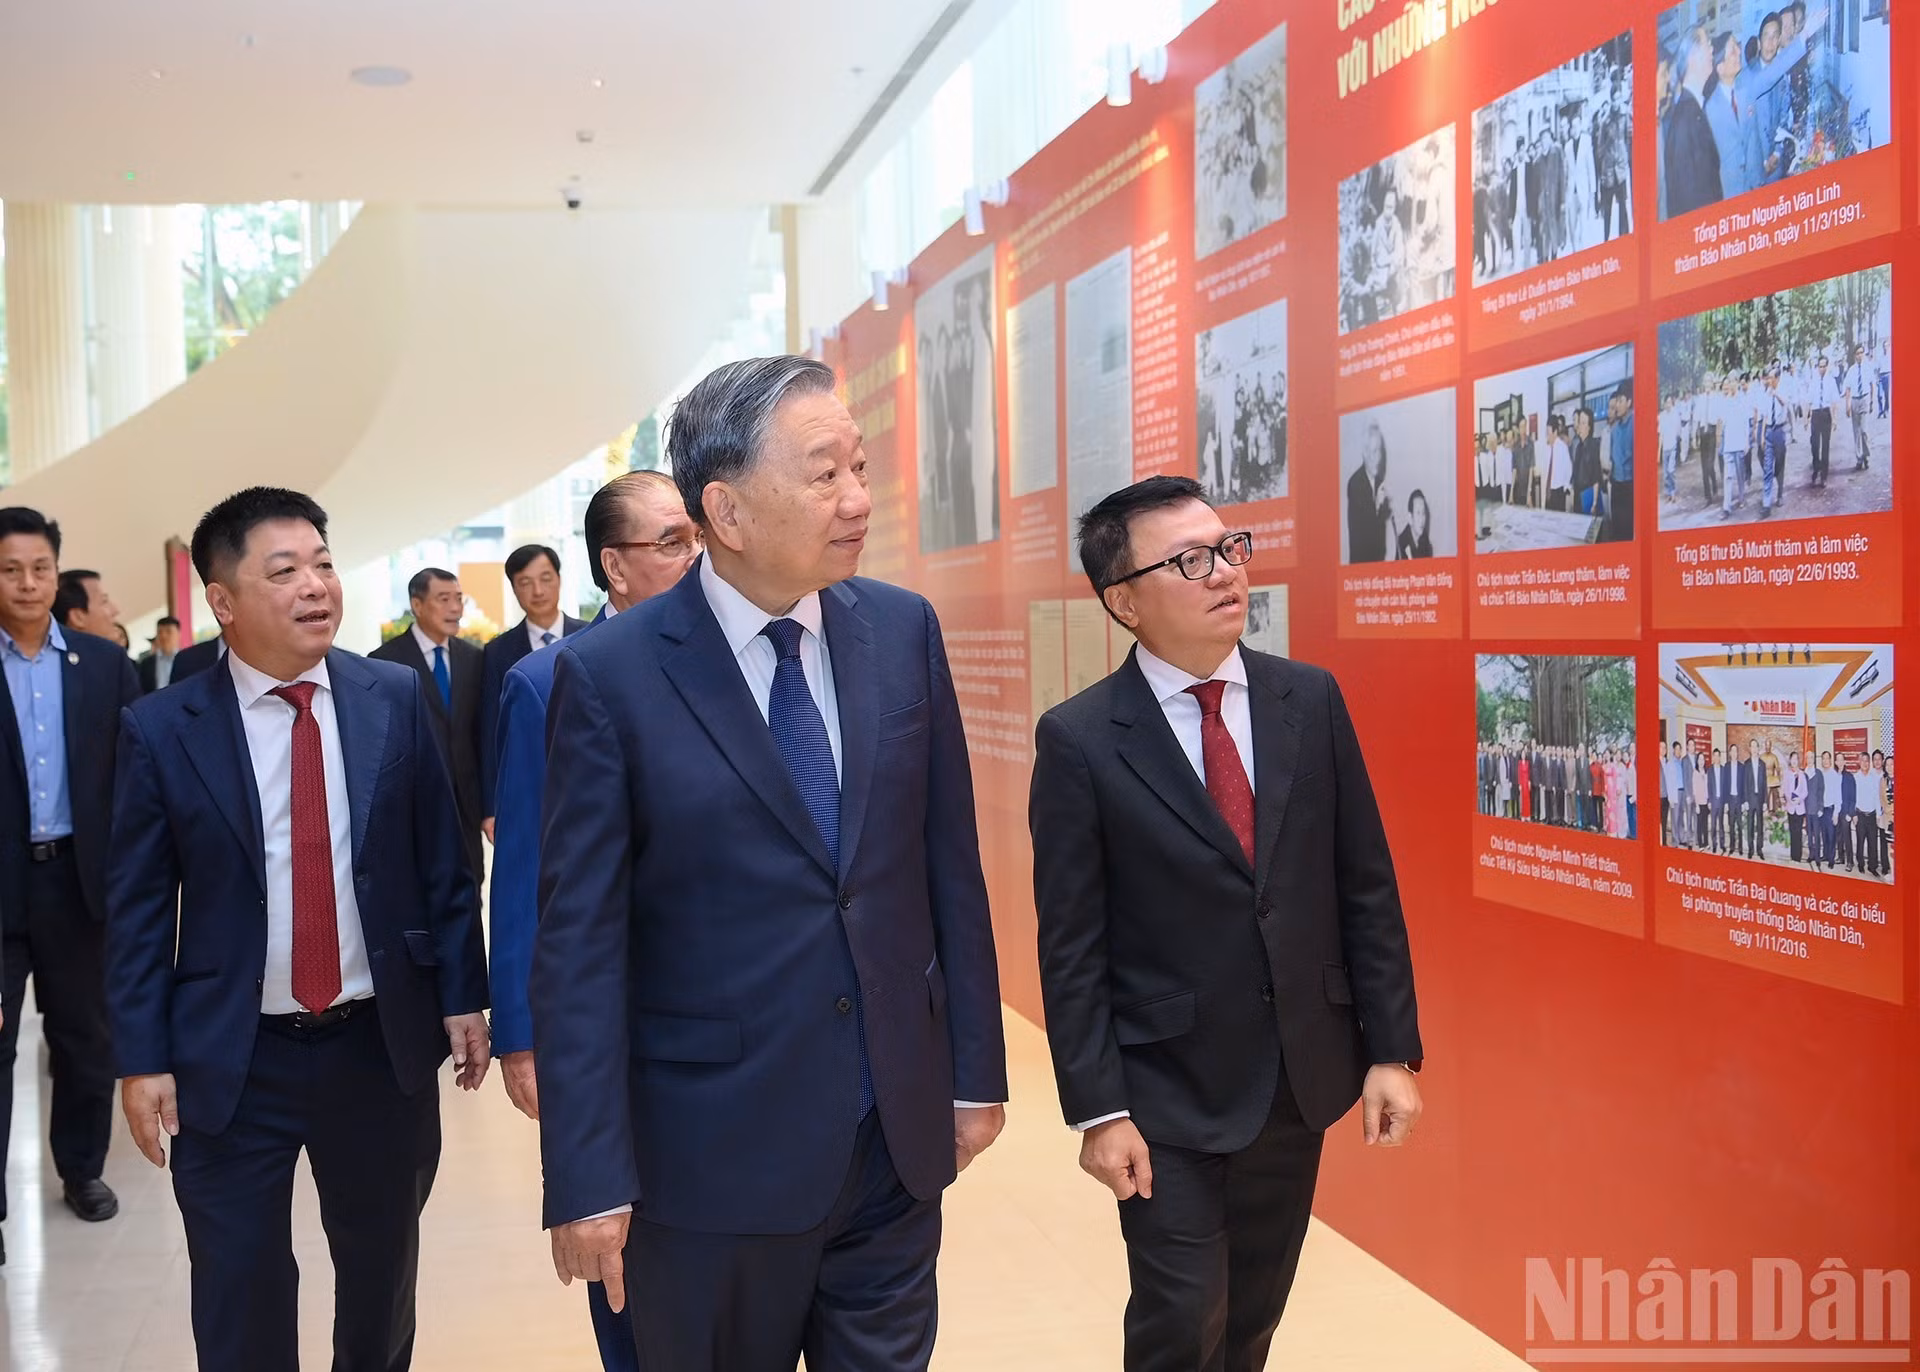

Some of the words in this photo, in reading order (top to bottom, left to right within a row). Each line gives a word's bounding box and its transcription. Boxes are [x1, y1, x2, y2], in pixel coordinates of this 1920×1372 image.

[1337, 37, 1368, 99] VỚI
[1373, 0, 1447, 78] NHỮNG
[1694, 221, 1717, 243] Tổng
[1719, 216, 1729, 236] Bí
[1730, 214, 1750, 232] Thư
[1752, 195, 1791, 227] Nguyễn
[1793, 191, 1813, 212] Văn
[1816, 182, 1840, 204] Linh
[1675, 254, 1698, 274] thăm
[1701, 247, 1718, 266] Báo
[1721, 238, 1746, 260] Nhân
[1749, 233, 1772, 252] Dân,
[1774, 225, 1800, 246] ngày
[1803, 202, 1866, 235] 11/3/1991.
[1675, 544, 1697, 565] Tổng
[1700, 544, 1710, 561] Bí
[1712, 544, 1727, 560] thư
[1730, 538, 1744, 559] Đỗ
[1746, 540, 1772, 558] Mười
[1774, 539, 1801, 556] thăm
[1804, 536, 1818, 554] và
[1820, 535, 1840, 554] làm
[1844, 532, 1868, 556] việc
[1477, 573, 1490, 587] Chủ
[1491, 573, 1503, 589] tịch
[1504, 572, 1521, 585] nước
[1522, 569, 1536, 584] Trần
[1537, 569, 1551, 583] Đức
[1552, 569, 1574, 585] Lương
[1576, 567, 1596, 582] thăm,
[1598, 565, 1612, 580] làm
[1614, 564, 1630, 583] việc
[1480, 594, 1488, 605] và
[1489, 593, 1504, 605] chúc
[1505, 591, 1516, 604] Tết
[1516, 590, 1529, 604] Báo
[1531, 590, 1548, 604] Nhân
[1550, 588, 1565, 604] Dân,
[1567, 589, 1584, 605] ngày
[1682, 571, 1694, 590] tại
[1696, 568, 1713, 586] Báo
[1716, 567, 1741, 585] Nhân
[1743, 565, 1767, 585] Dân,
[1769, 565, 1794, 586] ngày
[1797, 562, 1859, 581] 22/6/1993.
[1760, 700, 1779, 713] Nhân
[1780, 700, 1796, 713] Dân
[1480, 854, 1495, 868] chúc
[1496, 855, 1506, 870] Tết
[1532, 863, 1540, 881] tại
[1541, 865, 1555, 881] Báo
[1556, 868, 1574, 885] Nhân
[1575, 872, 1592, 891] Dân,
[1593, 877, 1610, 893] năm
[1611, 882, 1635, 899] 2009.
[1490, 835, 1503, 850] Chủ
[1504, 838, 1516, 854] tịch
[1518, 843, 1534, 857] nước
[1536, 845, 1561, 864] Nguyễn
[1563, 849, 1580, 866] Minh
[1581, 853, 1598, 869] Triết
[1599, 857, 1620, 878] thăm,
[1667, 867, 1682, 884] Chủ
[1685, 871, 1701, 890] tịch
[1703, 876, 1726, 893] nước
[1728, 878, 1748, 897] Trần
[1750, 883, 1767, 904] Đại
[1769, 886, 1801, 911] Quang
[1804, 894, 1817, 911] và
[1819, 896, 1838, 915] các
[1841, 900, 1858, 922] đại
[1861, 903, 1885, 924] biểu
[1682, 894, 1693, 912] tại
[1695, 897, 1722, 918] phòng
[1725, 902, 1754, 923] truyền
[1756, 908, 1783, 932] thống
[1787, 914, 1806, 933] Báo
[1809, 919, 1837, 940] Nhân
[1839, 925, 1865, 948] Dân,
[1729, 928, 1752, 948] ngày
[1754, 932, 1810, 959] 1/11/2016.
